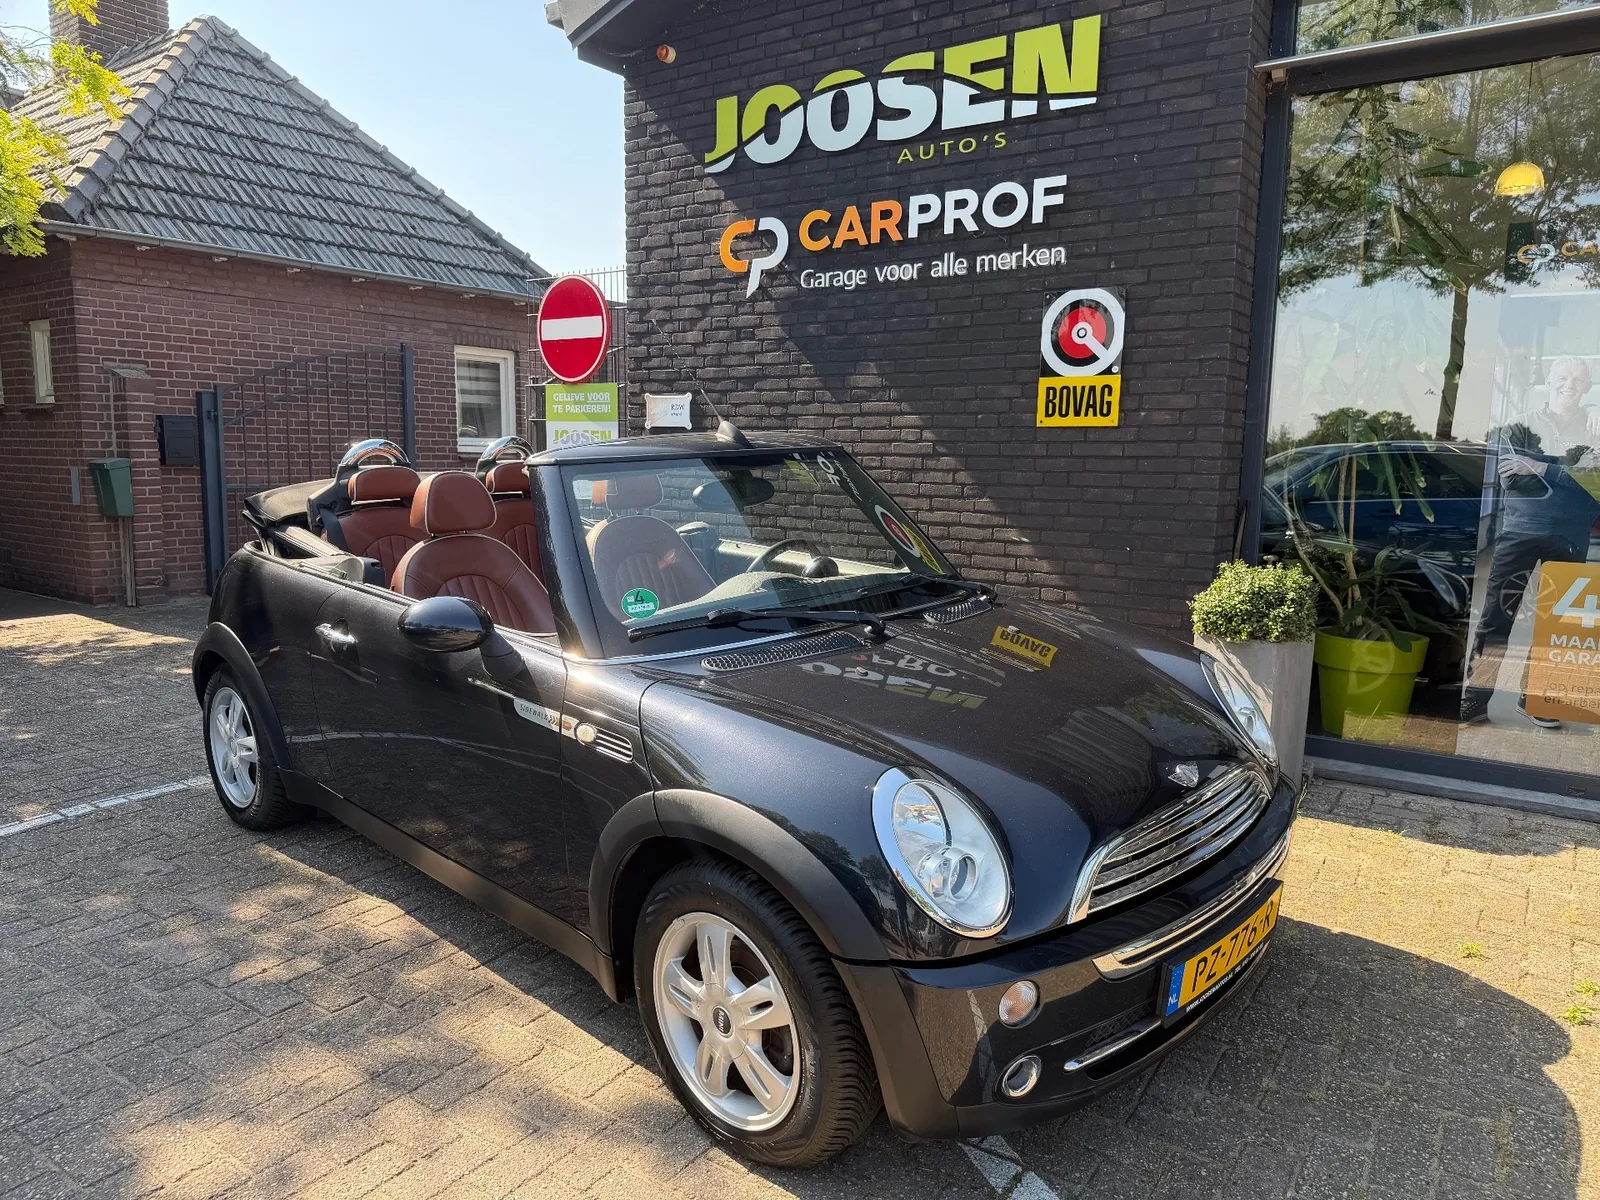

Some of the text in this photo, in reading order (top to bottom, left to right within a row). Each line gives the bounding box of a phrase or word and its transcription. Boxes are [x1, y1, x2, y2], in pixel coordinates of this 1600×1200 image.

[704, 14, 1101, 174] JOOSEN
[896, 131, 1008, 164] AUTO'S
[799, 174, 1067, 252] CARPROF
[800, 243, 1068, 290] Garage voor alle merken
[553, 391, 610, 402] GELIEVE VOOR
[553, 404, 611, 413] TE PARKEREN!
[1044, 384, 1113, 418] BOVAG
[553, 429, 612, 445] JOOSEN
[634, 590, 645, 604] 4
[1552, 577, 1600, 628] 4
[1550, 633, 1600, 651] MAA
[1192, 899, 1274, 993] PZ-776-R
[1168, 993, 1179, 1007] NL
